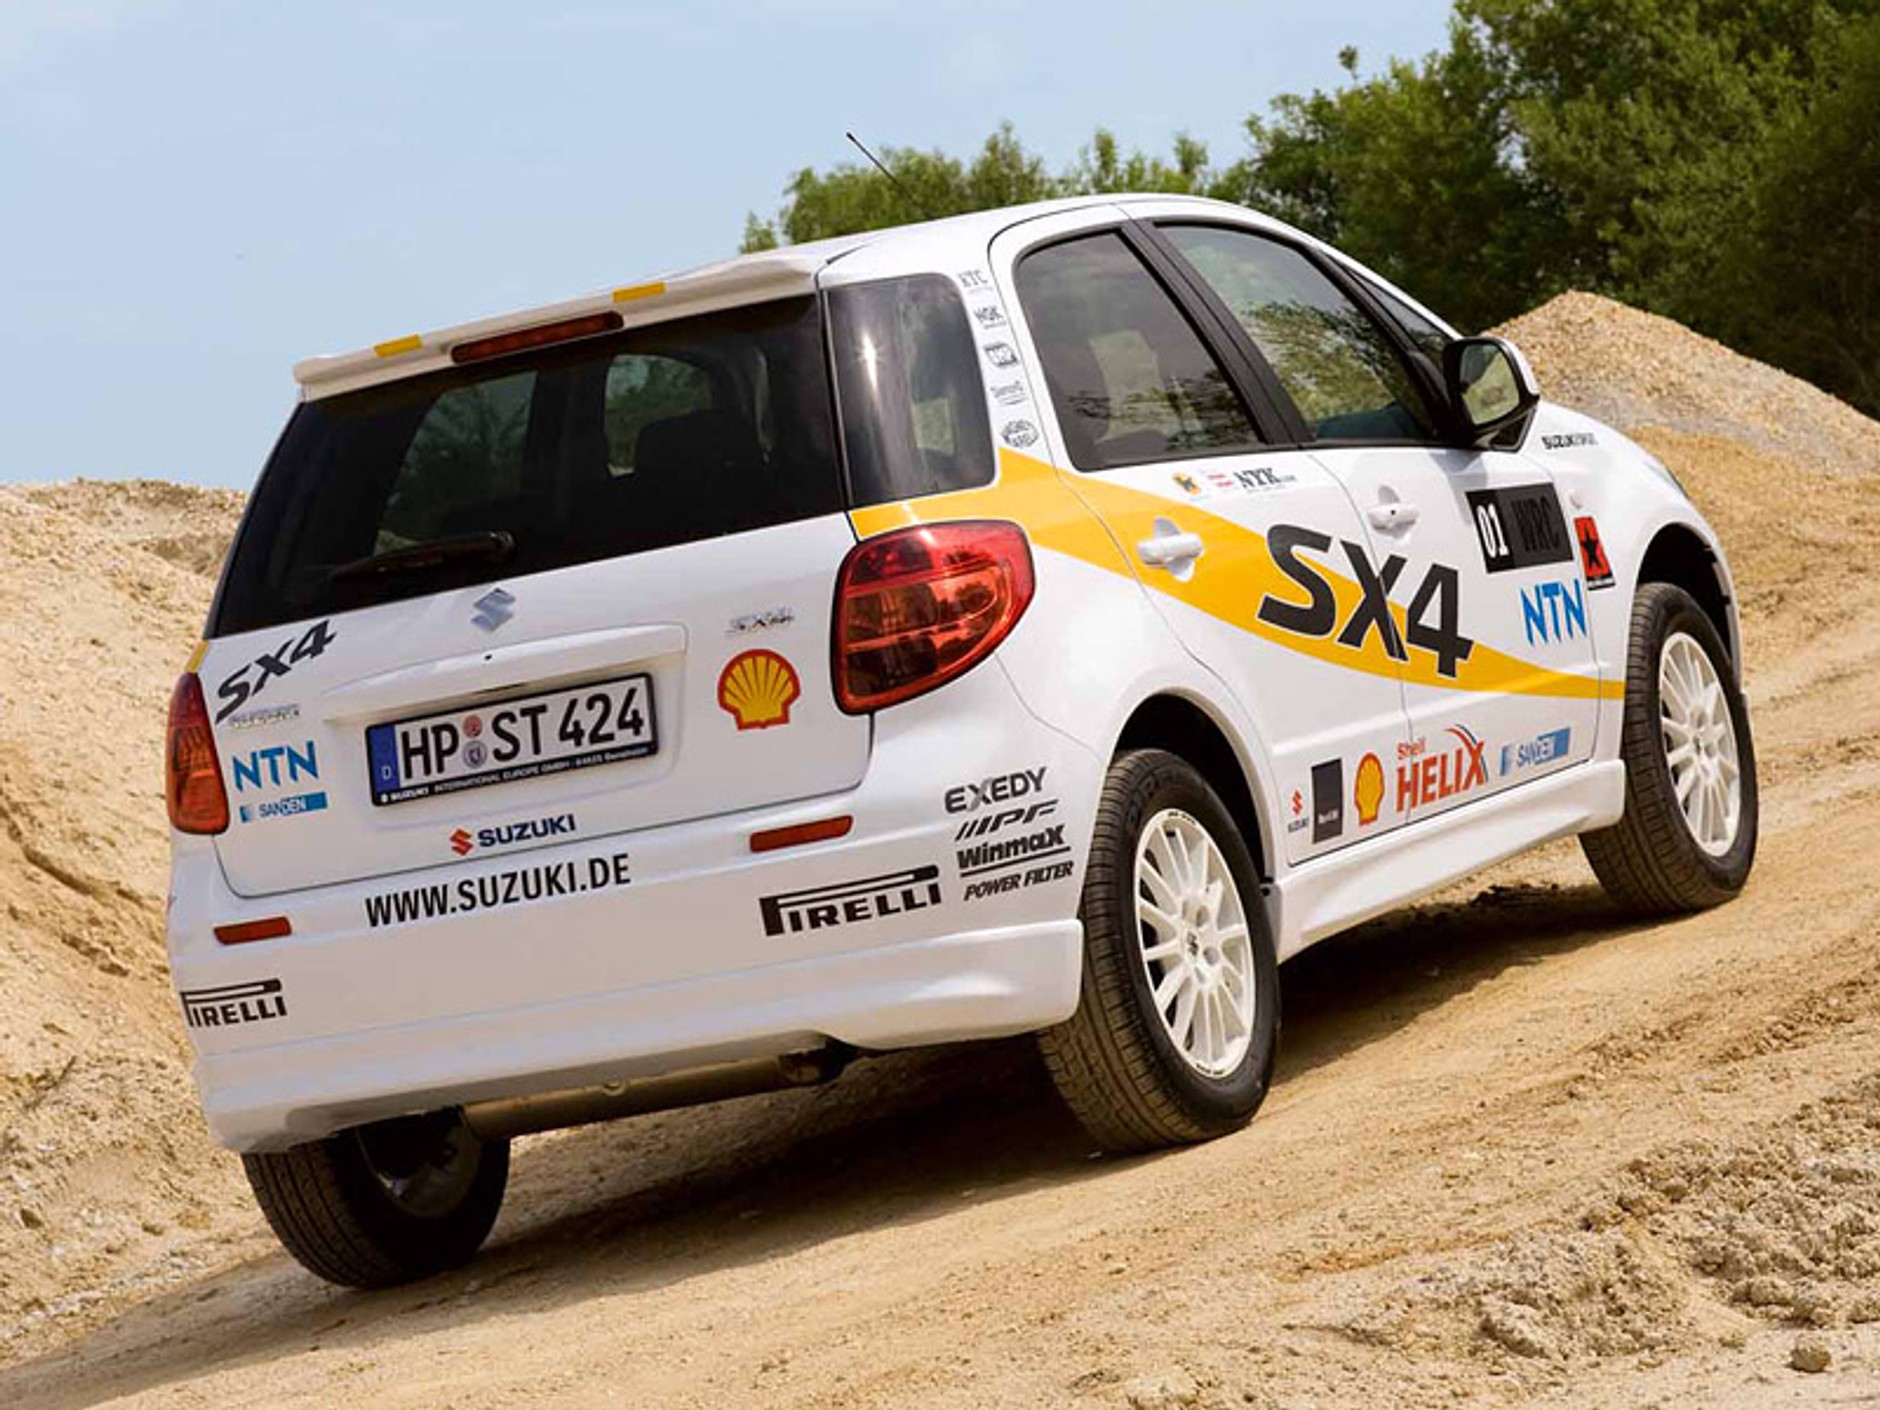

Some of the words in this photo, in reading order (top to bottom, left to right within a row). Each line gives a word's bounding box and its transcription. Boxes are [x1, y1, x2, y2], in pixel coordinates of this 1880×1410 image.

[1475, 503, 1509, 558] 01
[1257, 524, 1474, 678] SX4
[1520, 579, 1588, 646] NTN
[215, 619, 337, 724] SX4
[232, 740, 319, 792] NTN
[401, 722, 460, 779] HP
[491, 704, 548, 762] ST
[559, 687, 645, 747] 424
[944, 766, 1047, 814] EXEDY
[1396, 727, 1485, 814] HELIX
[477, 813, 576, 848] SUZUKI
[365, 853, 631, 928] WWW.SUZUKI.DE
[758, 864, 942, 936] PIRELLI
[963, 874, 1022, 901] POWER
[1023, 861, 1074, 887] FILTER
[179, 978, 287, 1028] PIRELLI
